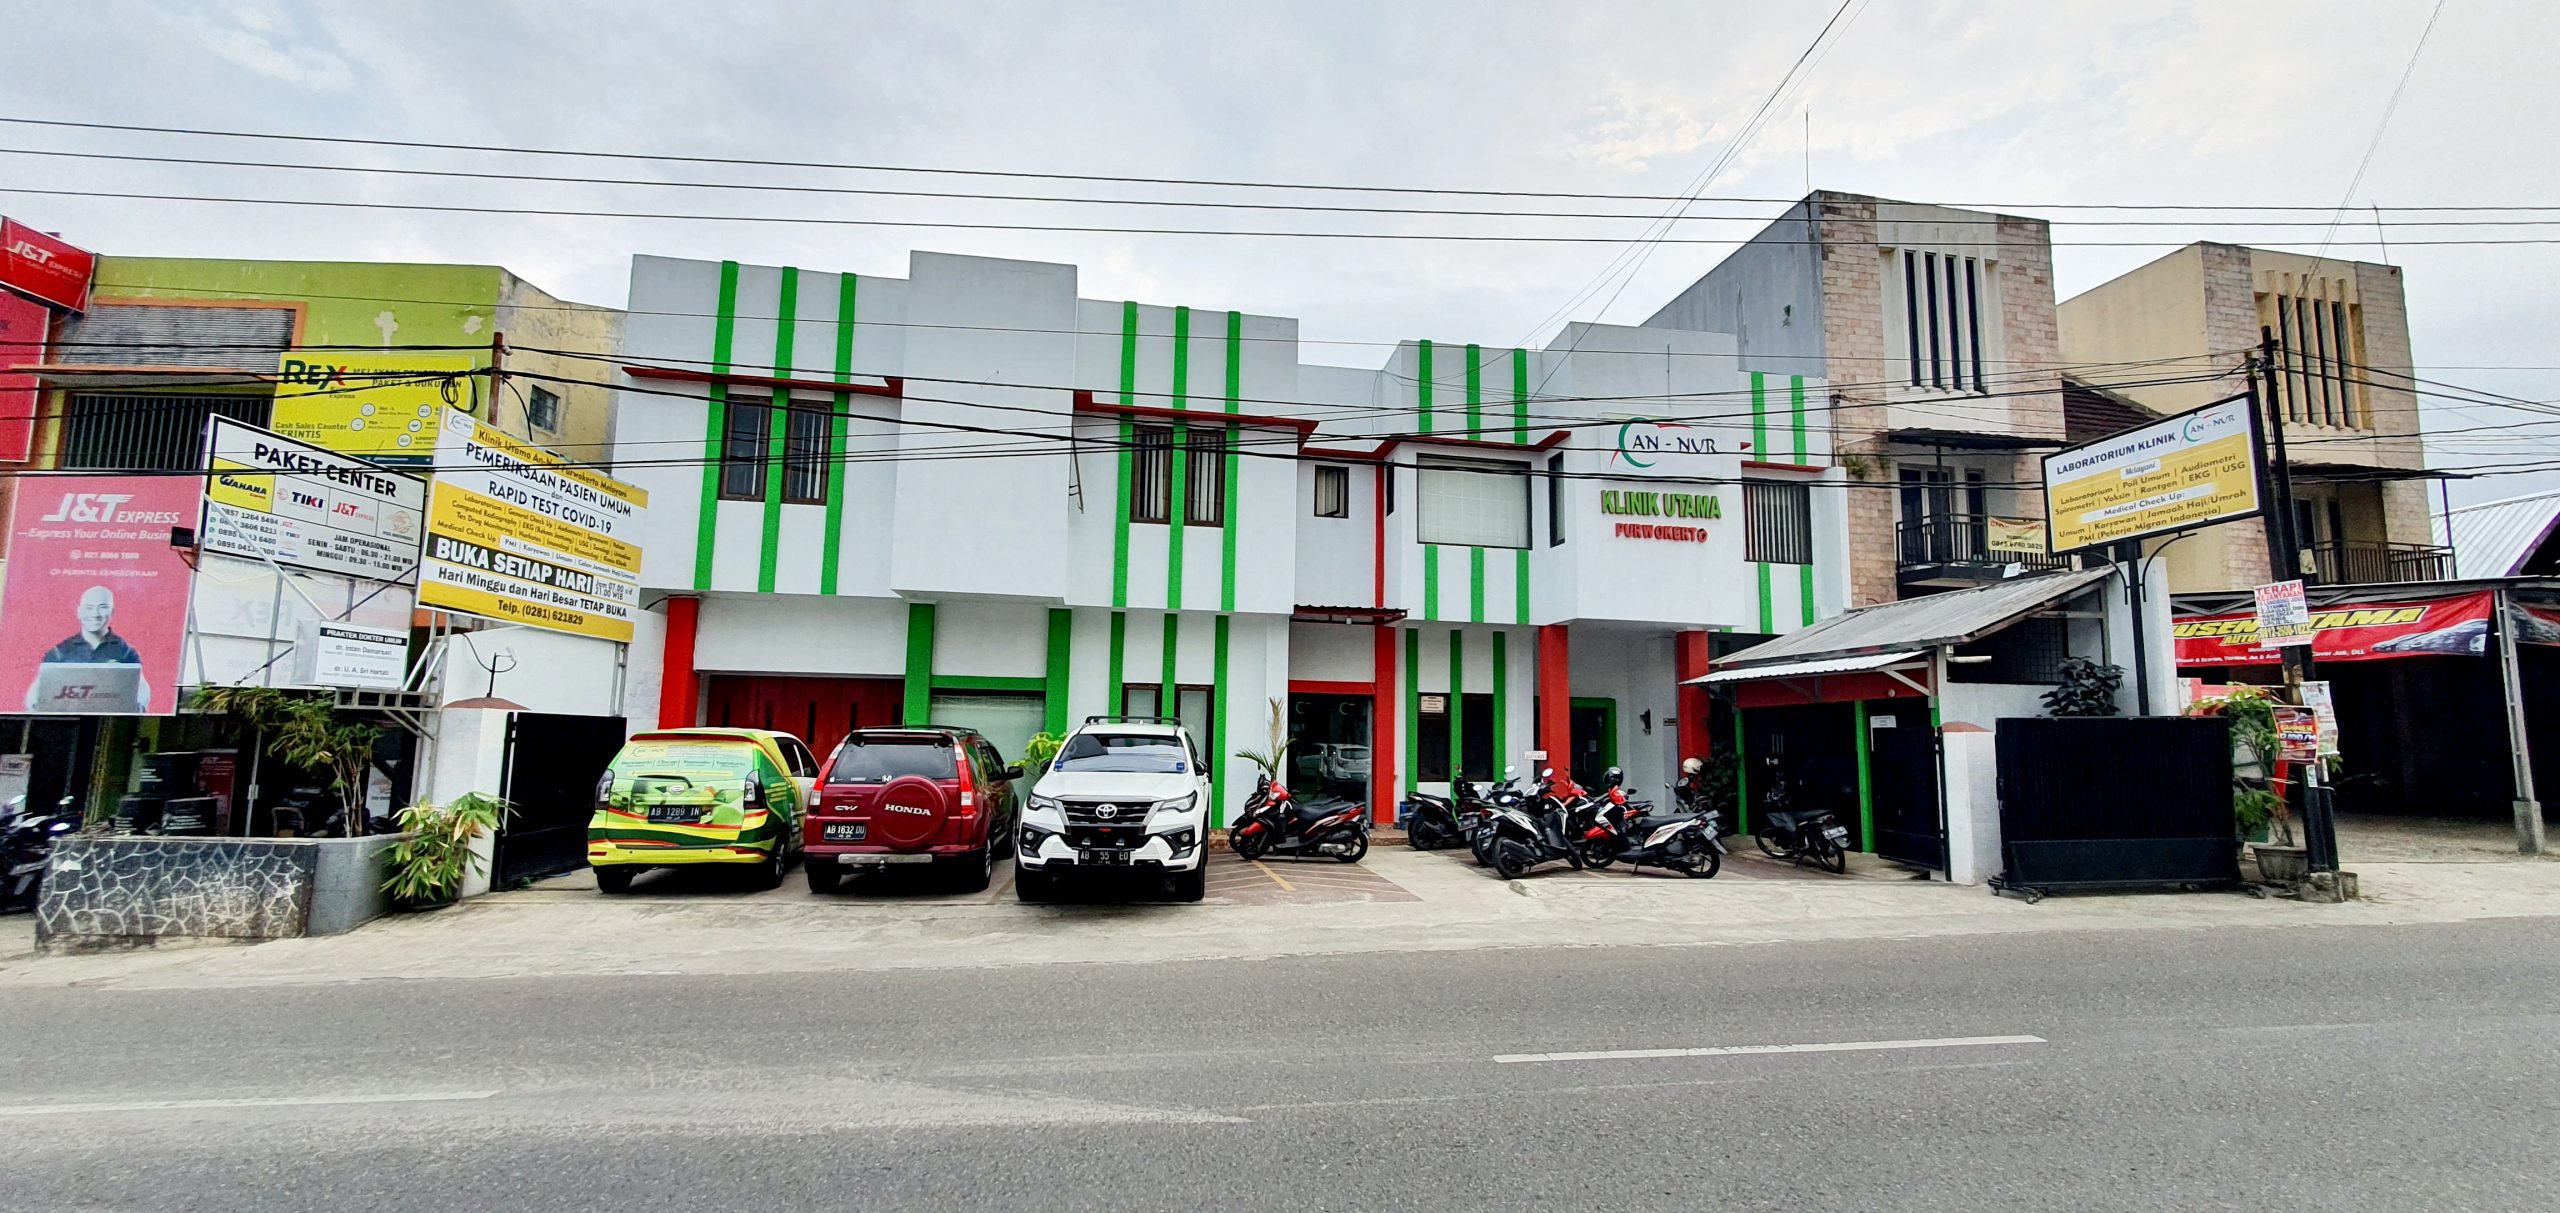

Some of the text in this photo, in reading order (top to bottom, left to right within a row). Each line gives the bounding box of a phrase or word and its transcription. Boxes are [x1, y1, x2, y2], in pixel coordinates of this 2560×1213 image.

[5, 240, 56, 264] J&T
[275, 422, 348, 431] Cash Sales Counter
[478, 430, 502, 447] Klinik
[504, 441, 531, 460] Utama
[1632, 434, 1718, 454] AN NUR
[2056, 432, 2177, 475] LABORATORIUM KLINIK
[254, 442, 397, 498] PAKET CENTER
[466, 442, 631, 517] PEMERIKSAAN PASIEN UMUM
[2060, 454, 2237, 505] Laboratorium Poli Umum Audiometri
[219, 473, 268, 496] WAHANA
[551, 491, 563, 500] dan
[2055, 461, 2246, 516] Spirometri Vaksin Rontgen EKG USG
[41, 493, 181, 524] J&T EXPRESS
[291, 491, 324, 509] TIKI
[332, 502, 360, 517] J&T
[489, 480, 612, 533] RAPID TEST COVID-19
[1600, 489, 1722, 519] KLINIK UTAMA
[2104, 503, 2137, 517] Medical
[2139, 497, 2167, 509] Check
[437, 519, 465, 533] Medical
[466, 528, 486, 541] Check
[487, 533, 497, 543] Up
[2059, 504, 2184, 538] Umum Karyawan Jamaah
[2078, 506, 2222, 543] PMI (Pekerja Migran Indonesia)
[28, 528, 72, 541] Express
[73, 528, 99, 540] Your
[100, 530, 138, 541] Online
[334, 534, 391, 552] JAM OPERASIONAL
[307, 538, 328, 548] SENIN
[335, 543, 356, 554] SABTU
[402, 557, 414, 566] WIB
[316, 550, 344, 562] MINGGU
[391, 564, 403, 572] WIB
[436, 536, 592, 594] BUKA SETIAP HARI
[438, 566, 627, 618] Hari Minggu dan Hari Besar TETAP BUKA
[612, 591, 624, 601] WIB
[2255, 582, 2303, 595] TERAPI
[498, 599, 584, 626] Telp. (0281) 621829
[326, 629, 358, 640] PRAKTEK
[650, 807, 700, 816] AB 1289 IN
[884, 803, 932, 817] HONDA
[826, 825, 836, 834] AB
[837, 825, 855, 834] 1632
[1080, 851, 1090, 860] AB
[1100, 851, 1110, 860] 55
